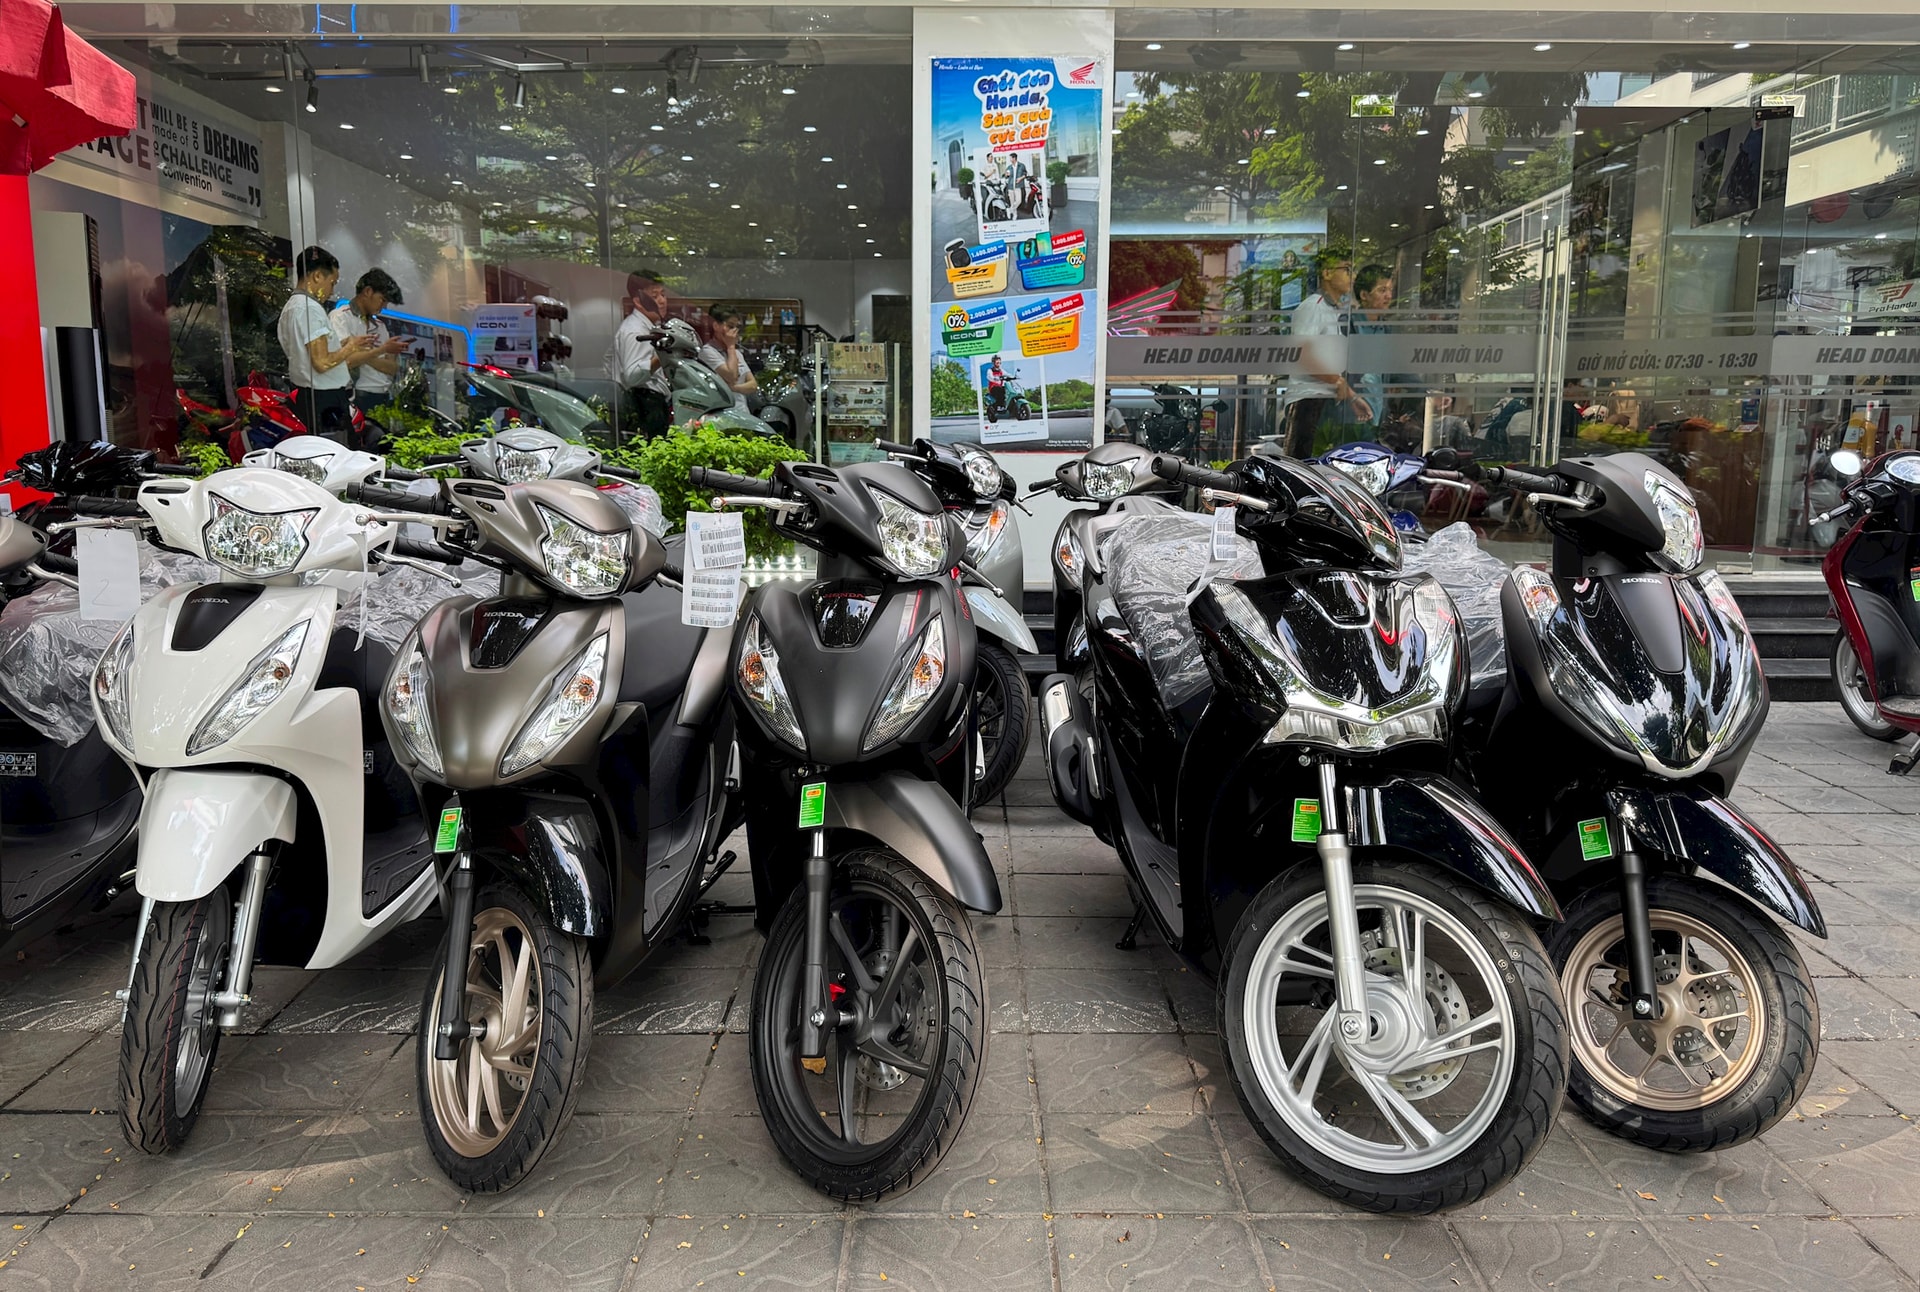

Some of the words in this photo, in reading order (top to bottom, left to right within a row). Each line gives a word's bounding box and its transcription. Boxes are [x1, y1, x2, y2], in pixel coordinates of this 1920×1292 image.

[978, 72, 1015, 94] Chốt
[1019, 72, 1050, 89] đơn
[986, 90, 1044, 110] Honda,
[150, 102, 173, 126] WILL
[176, 113, 188, 132] BE
[152, 124, 177, 142] made
[180, 136, 188, 147] of
[78, 135, 151, 170] AGE
[203, 125, 259, 174] DREAMS
[161, 144, 232, 185] CHALLENGE
[163, 166, 212, 192] convention
[1070, 256, 1082, 265] 0%
[948, 315, 965, 327] 0%
[950, 332, 975, 340] ICON
[1144, 348, 1192, 363] HEAD
[1197, 348, 1262, 363] DOANH
[1267, 347, 1302, 362] THU
[1411, 348, 1438, 363] XIN
[1441, 344, 1471, 363] MỜI
[1475, 345, 1503, 363] VÀO
[1577, 353, 1601, 371] GIỜ
[1603, 351, 1628, 371] MỞ
[1629, 350, 1660, 370] CỬA:
[1664, 354, 1704, 369] 07:30
[1718, 353, 1758, 368] 18:30
[1816, 348, 1866, 363] HEAD
